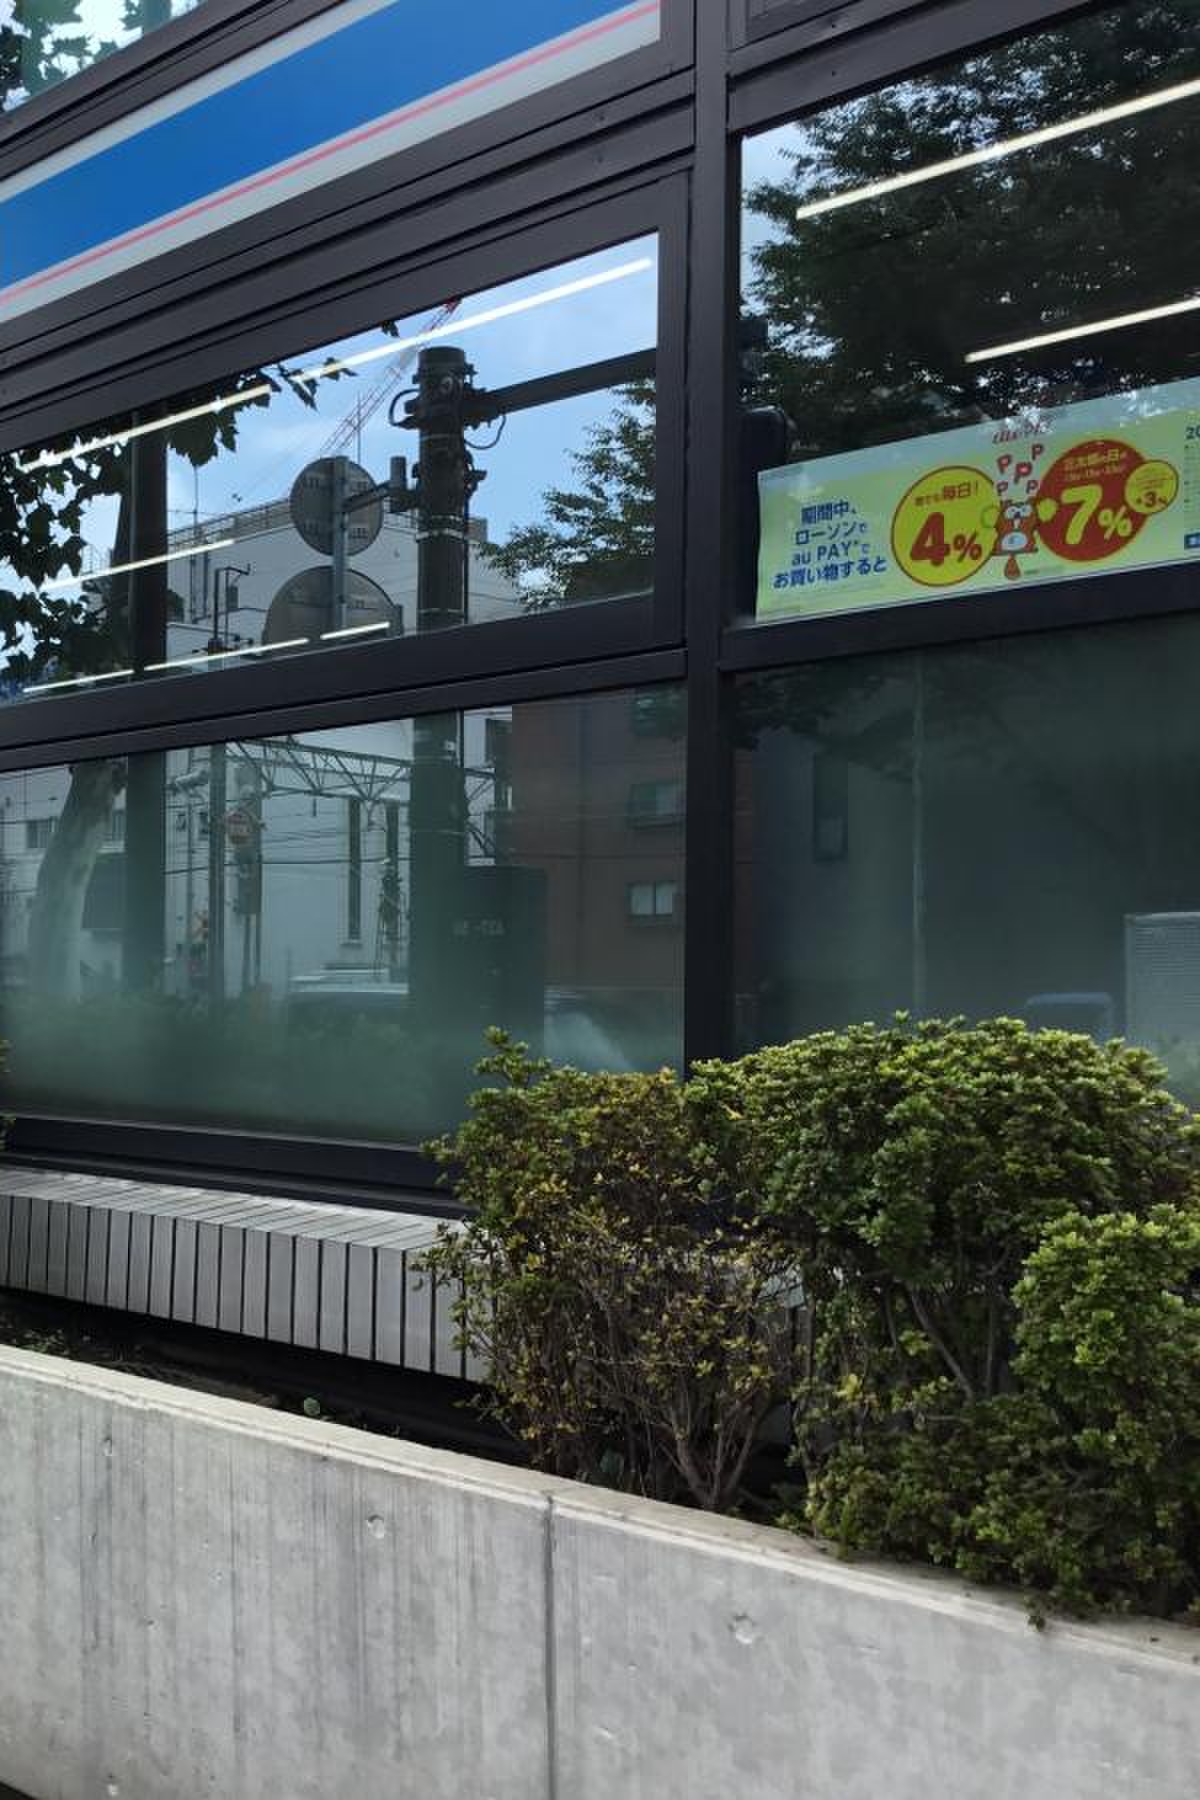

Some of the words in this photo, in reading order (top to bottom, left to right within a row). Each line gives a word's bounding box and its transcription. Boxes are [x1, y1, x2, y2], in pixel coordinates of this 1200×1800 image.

[1061, 484, 1133, 545] 7%
[796, 521, 867, 545] ローソンで
[910, 512, 982, 566] 4%
[773, 556, 887, 588] お買い物すると
[792, 552, 811, 566] au
